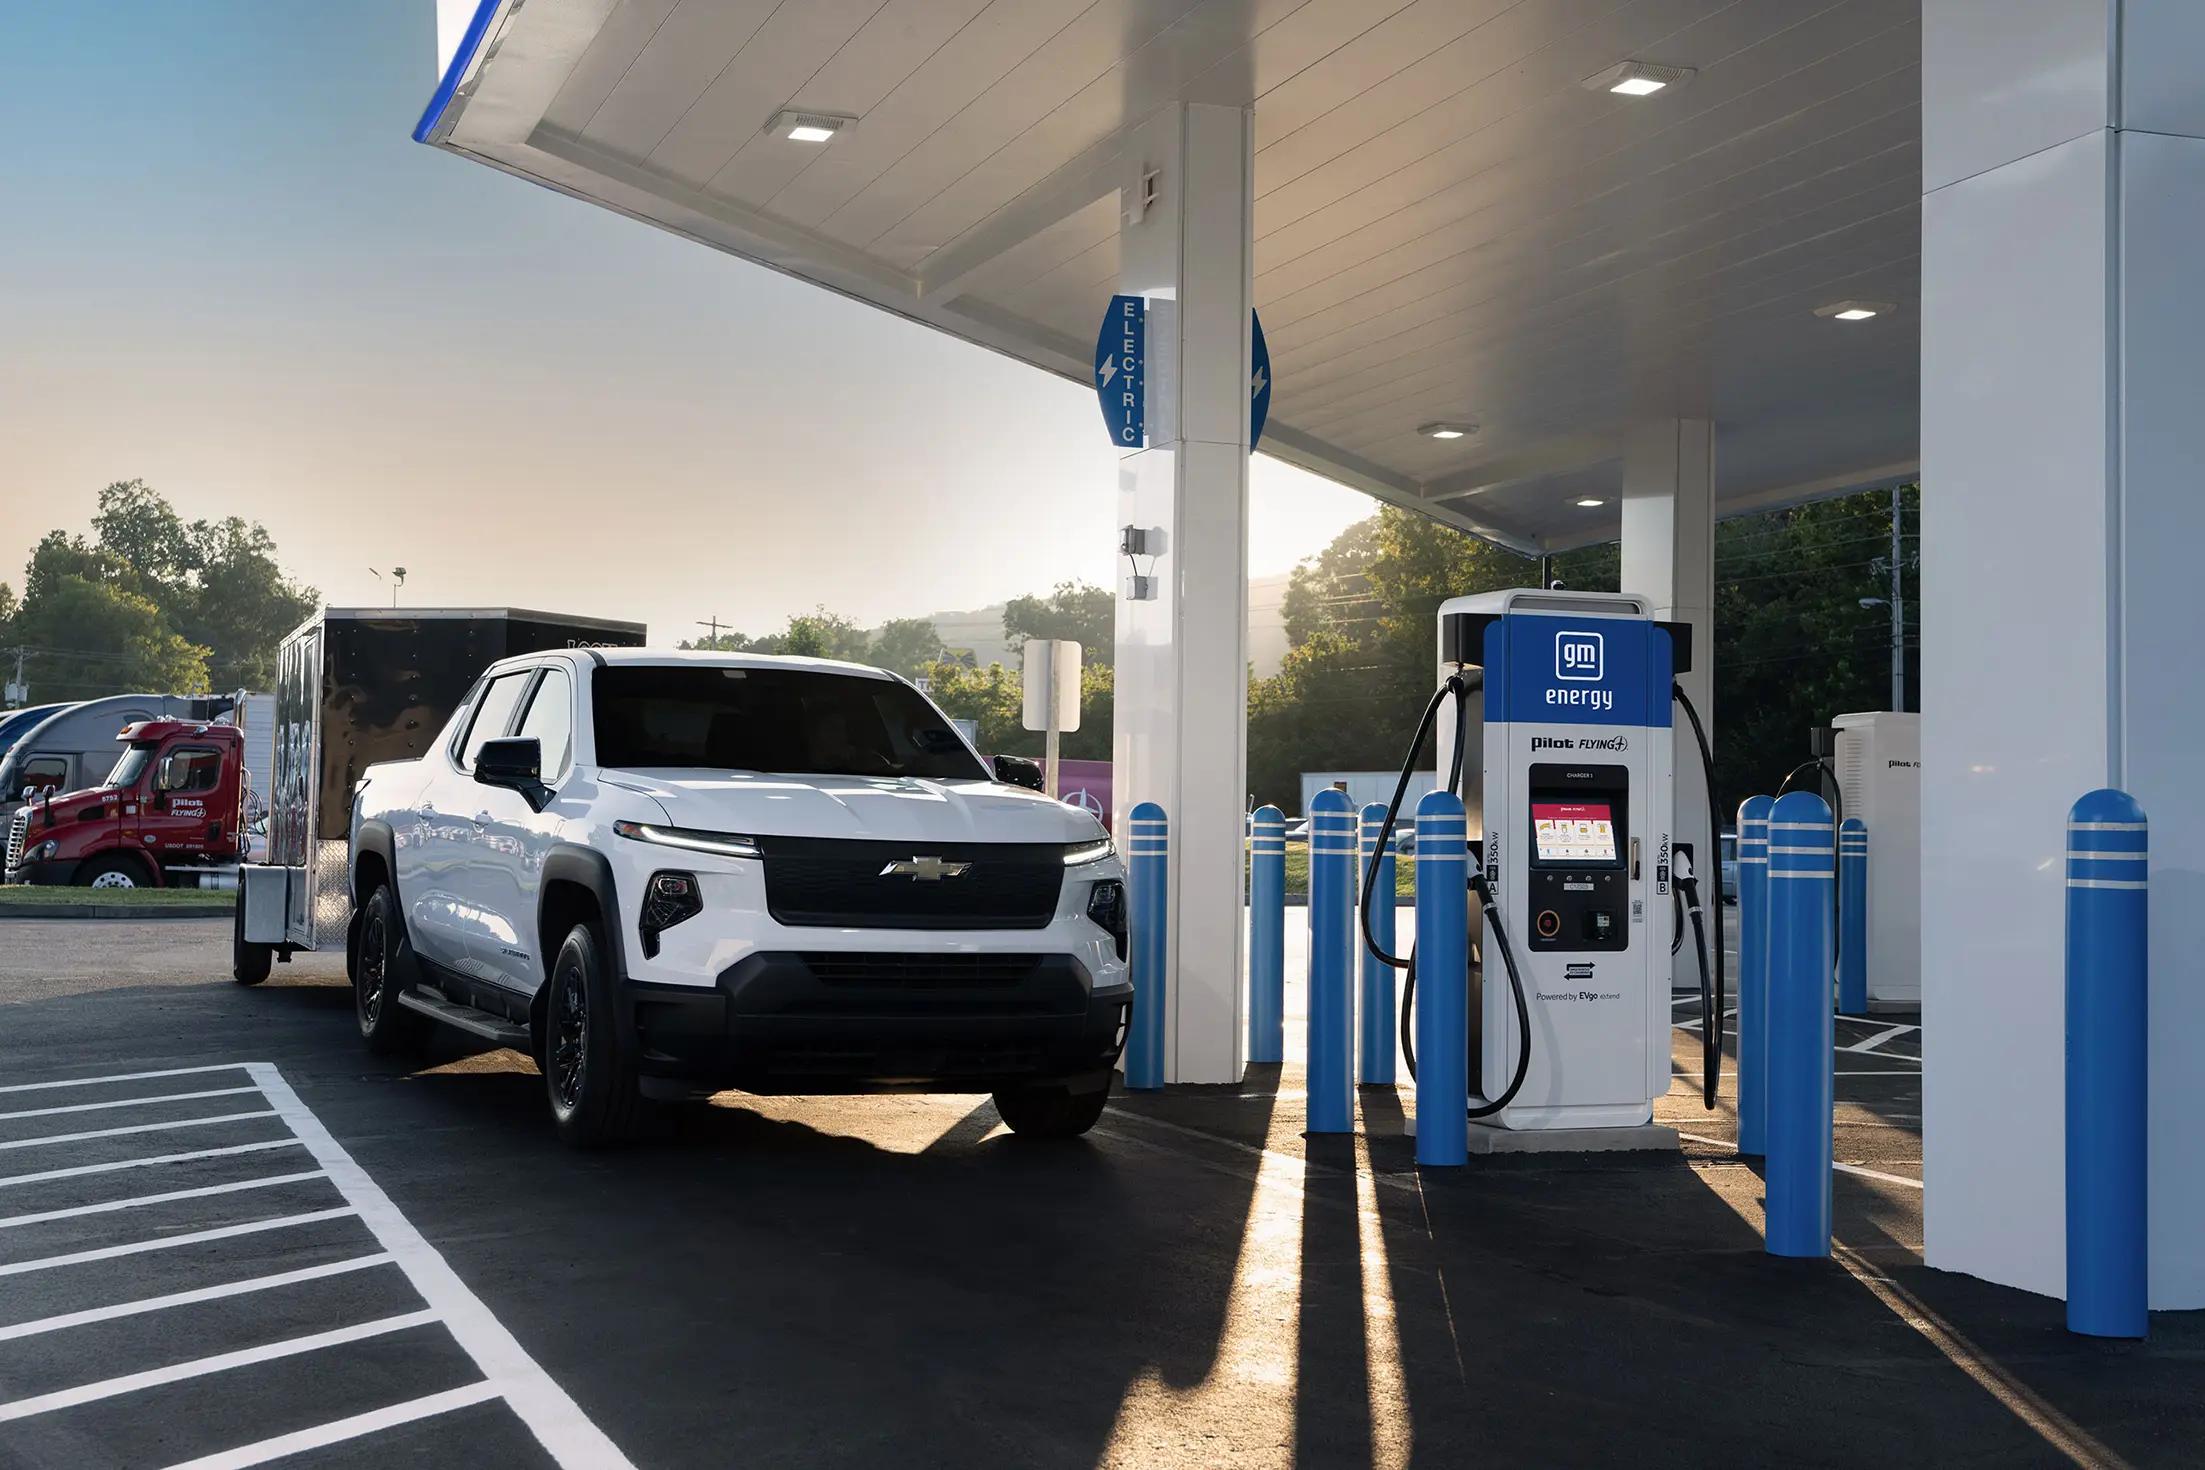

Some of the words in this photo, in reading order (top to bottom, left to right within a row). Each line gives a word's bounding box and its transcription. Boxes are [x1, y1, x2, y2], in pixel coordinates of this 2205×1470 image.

[1122, 302, 1135, 442] ELECTRIC
[1564, 643, 1595, 669] gm
[1546, 689, 1612, 710] energy
[1659, 882, 1666, 893] B
[1536, 992, 1568, 1001] Powered
[1568, 993, 1578, 1002] by
[1579, 991, 1599, 1002] EVgo
